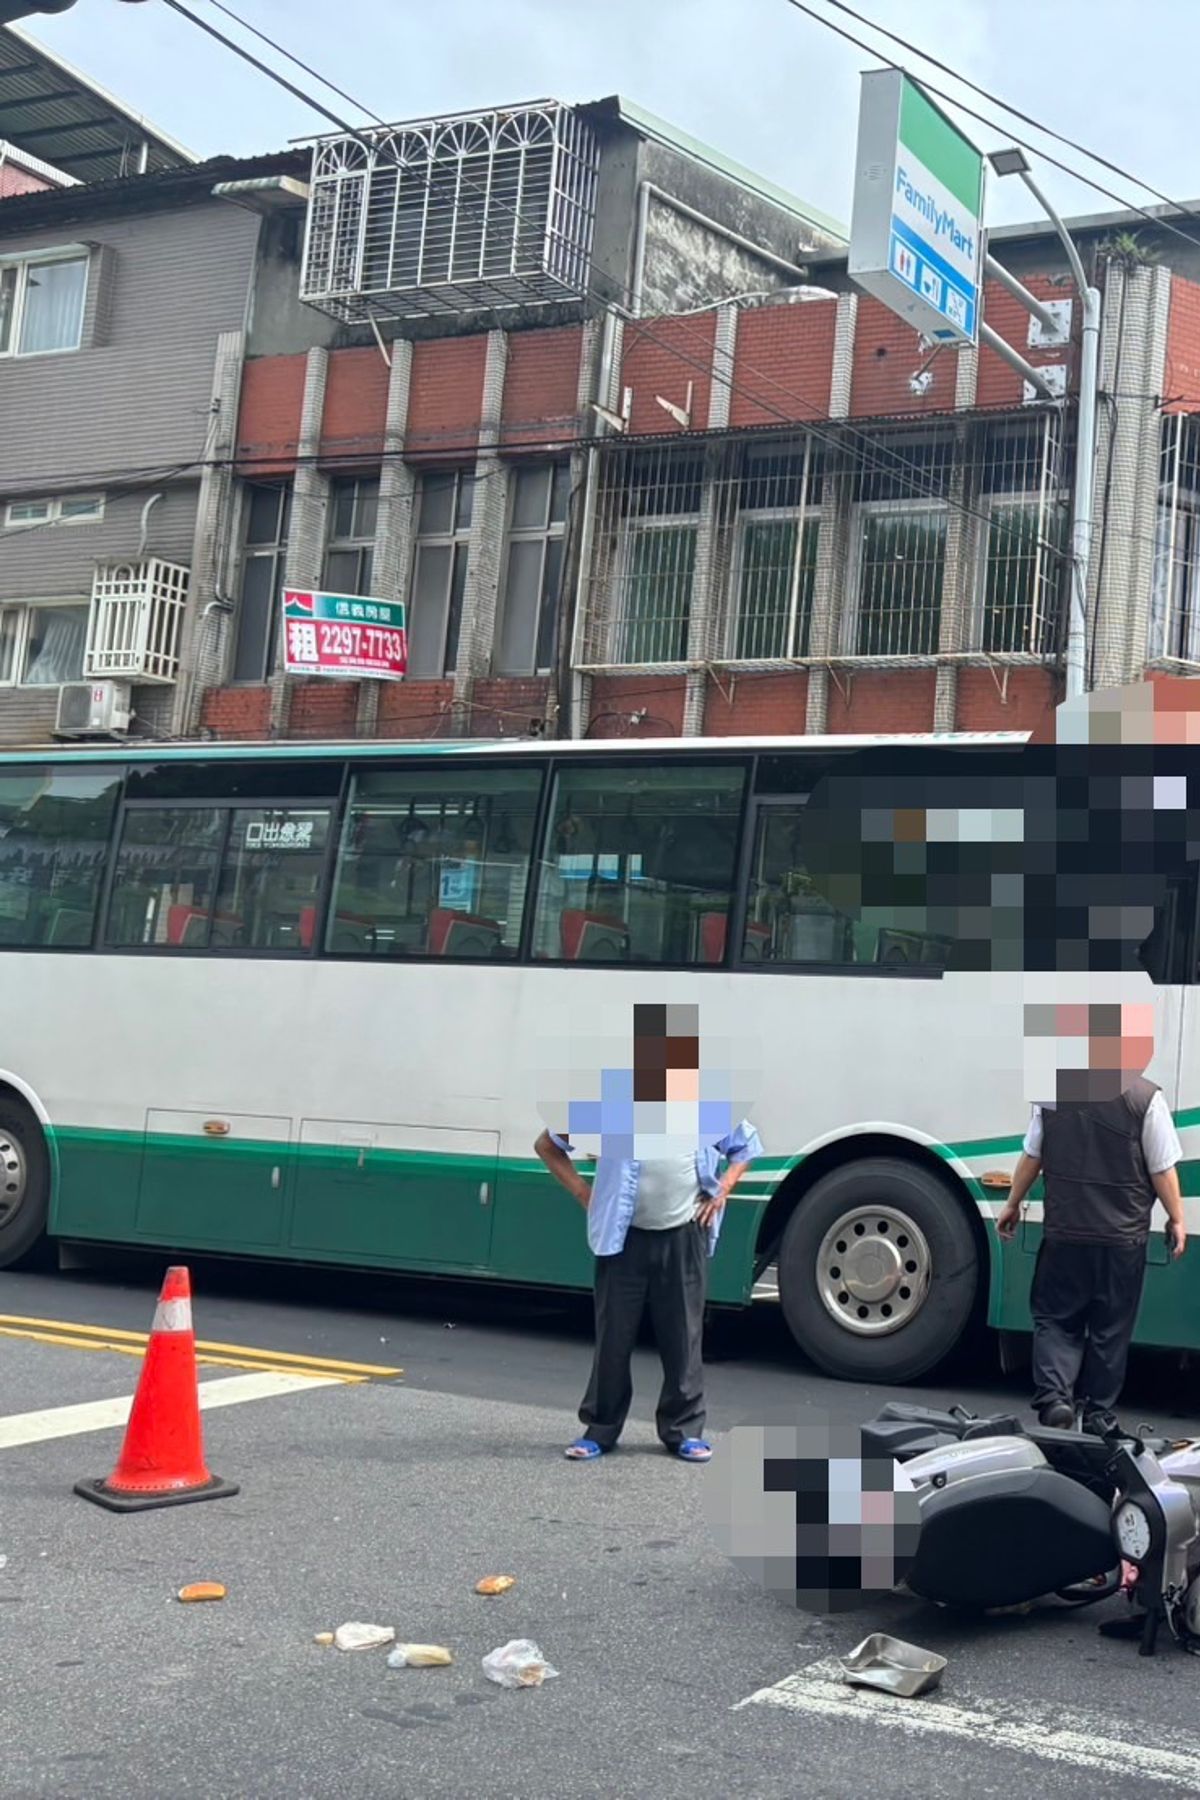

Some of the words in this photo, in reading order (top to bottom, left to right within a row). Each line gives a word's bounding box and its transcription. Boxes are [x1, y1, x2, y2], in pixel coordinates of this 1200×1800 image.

[896, 165, 973, 259] FamilyMart
[288, 622, 319, 662] 租
[320, 624, 400, 661] 2297-7733
